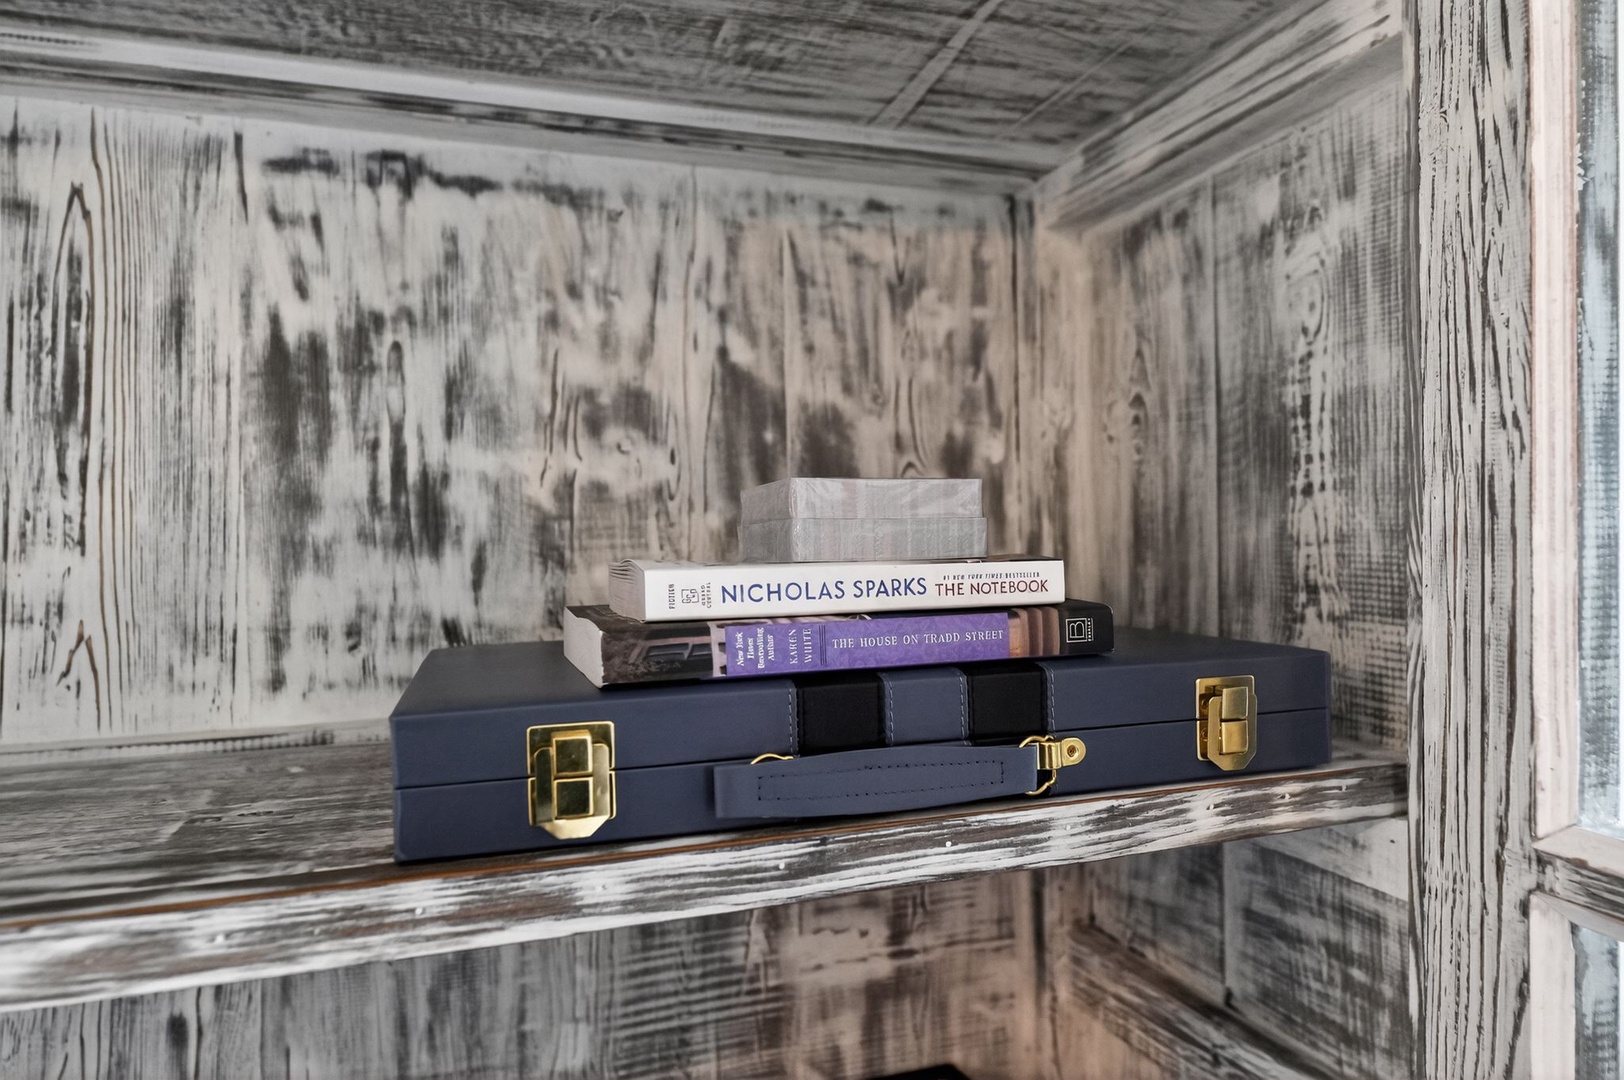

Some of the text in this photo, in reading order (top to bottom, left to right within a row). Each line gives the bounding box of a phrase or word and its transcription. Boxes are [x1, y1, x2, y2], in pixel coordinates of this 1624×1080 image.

[935, 579, 1049, 597] THE NOTEBOOK
[1005, 571, 1040, 579] BESTSELLER
[721, 577, 927, 604] NICHOLAS SPARKS
[735, 631, 745, 667] New York
[788, 629, 799, 665] KAREN
[802, 628, 813, 664] WHITE
[832, 629, 1004, 649] THE HOUSE ON TRADD STREET
